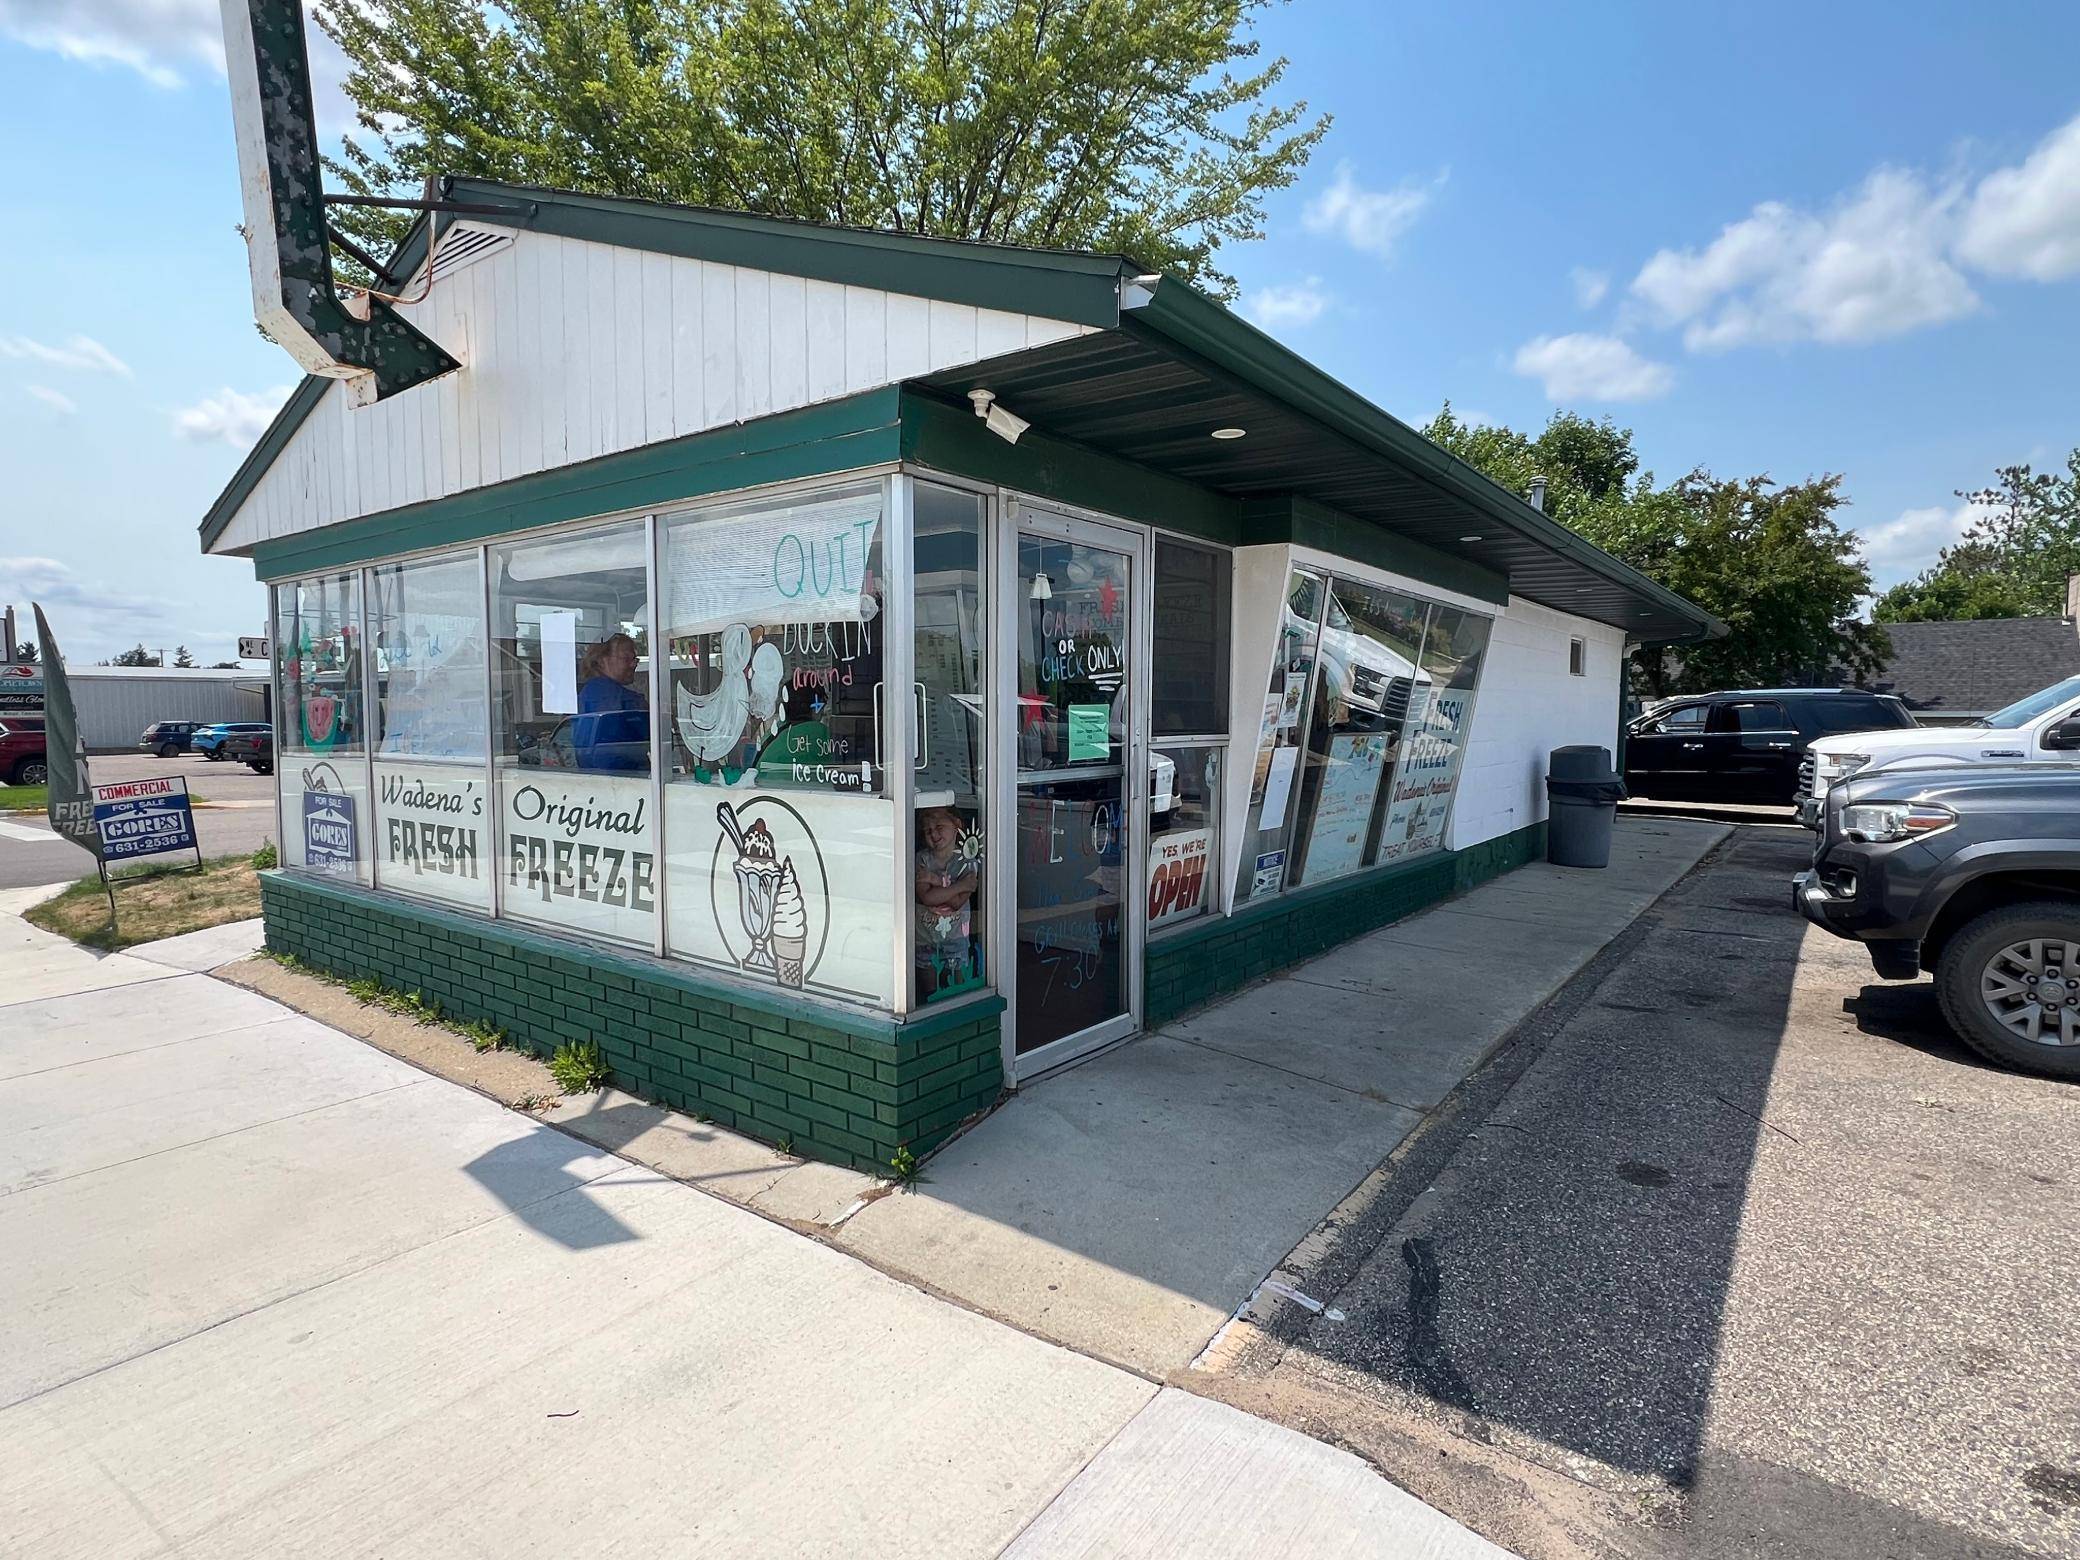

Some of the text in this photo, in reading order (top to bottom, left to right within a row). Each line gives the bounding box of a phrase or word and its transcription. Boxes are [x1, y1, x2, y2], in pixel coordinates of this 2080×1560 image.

[774, 519, 875, 598] QUIT
[1042, 610, 1093, 639] CASH
[1058, 638, 1076, 655] OR
[793, 665, 854, 691] around
[1041, 656, 1086, 682] CHECK
[1421, 690, 1464, 733] FRESH
[786, 723, 850, 757] Get some
[1405, 730, 1452, 773] FREEZE
[99, 780, 175, 800] COMMERCIAL
[314, 796, 327, 805] FOR
[381, 775, 483, 816] Wadena's
[111, 799, 165, 811] FOR SALE
[513, 785, 645, 838] Original
[107, 815, 179, 837] GORES
[311, 823, 348, 847] GORES
[115, 835, 179, 853] 631-2536
[388, 818, 478, 880] FRESH
[1181, 839, 1207, 855] WE'RE
[509, 834, 655, 913] FREEZE
[1148, 853, 1207, 921] OPEN
[1040, 943, 1097, 1007] 7:30
